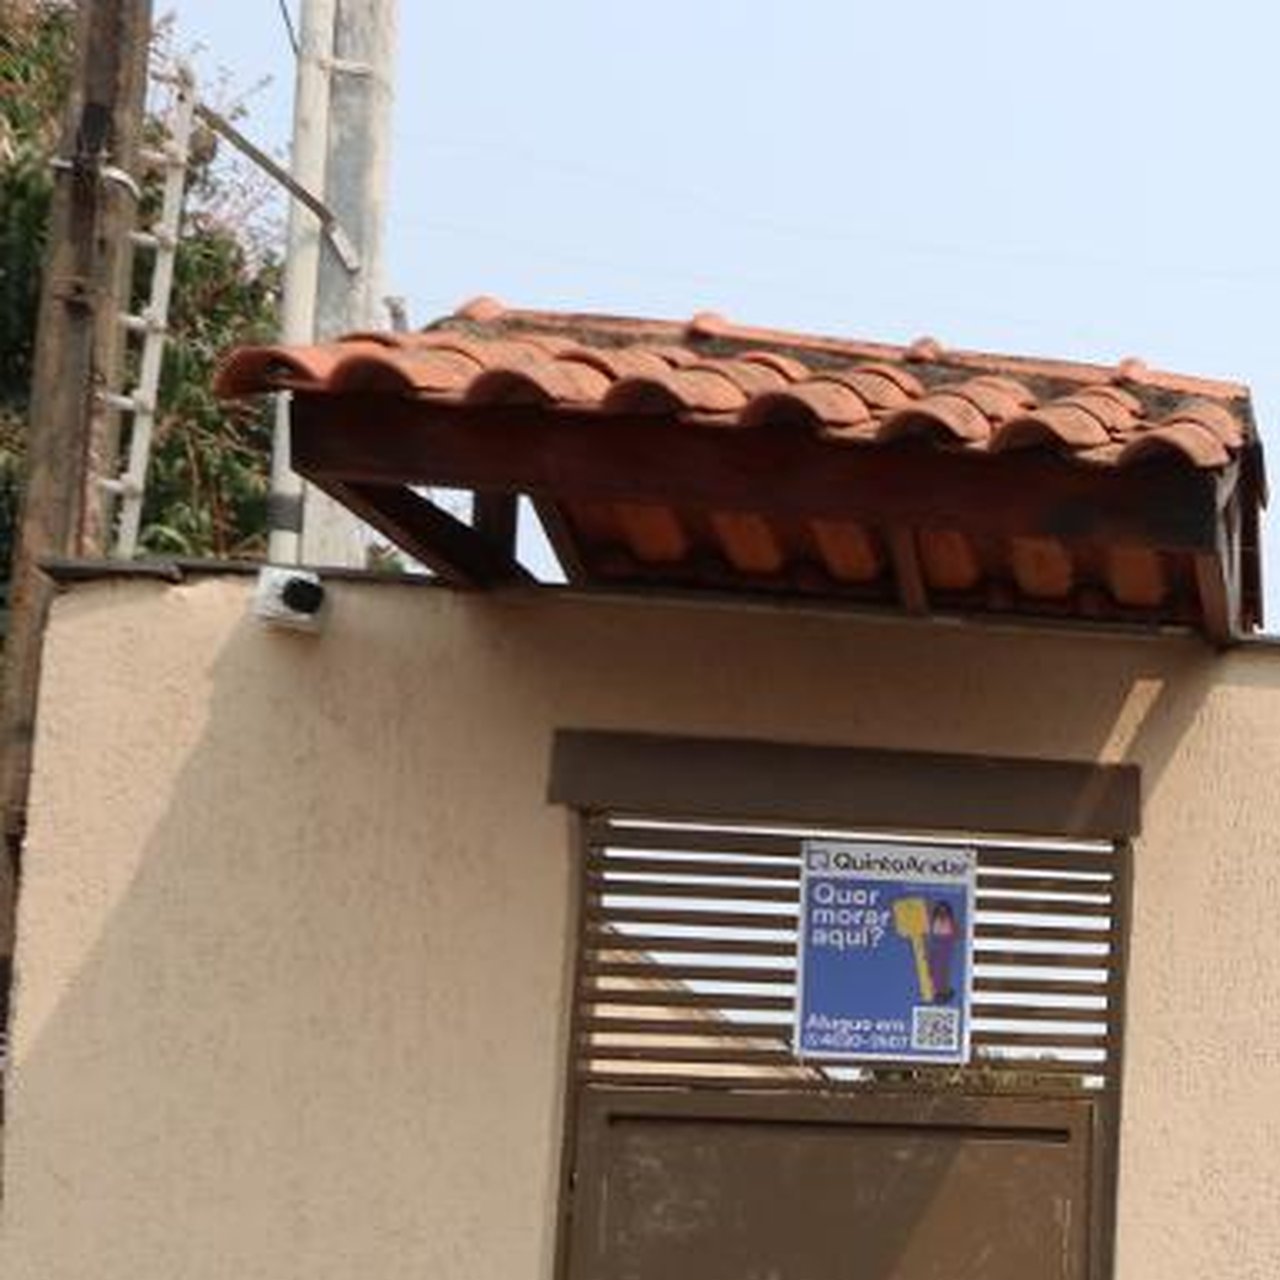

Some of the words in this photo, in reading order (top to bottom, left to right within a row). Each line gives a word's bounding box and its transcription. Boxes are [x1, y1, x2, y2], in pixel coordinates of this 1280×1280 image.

[813, 882, 880, 907] Quer
[811, 908, 891, 926] morar
[811, 926, 885, 950] aqui?
